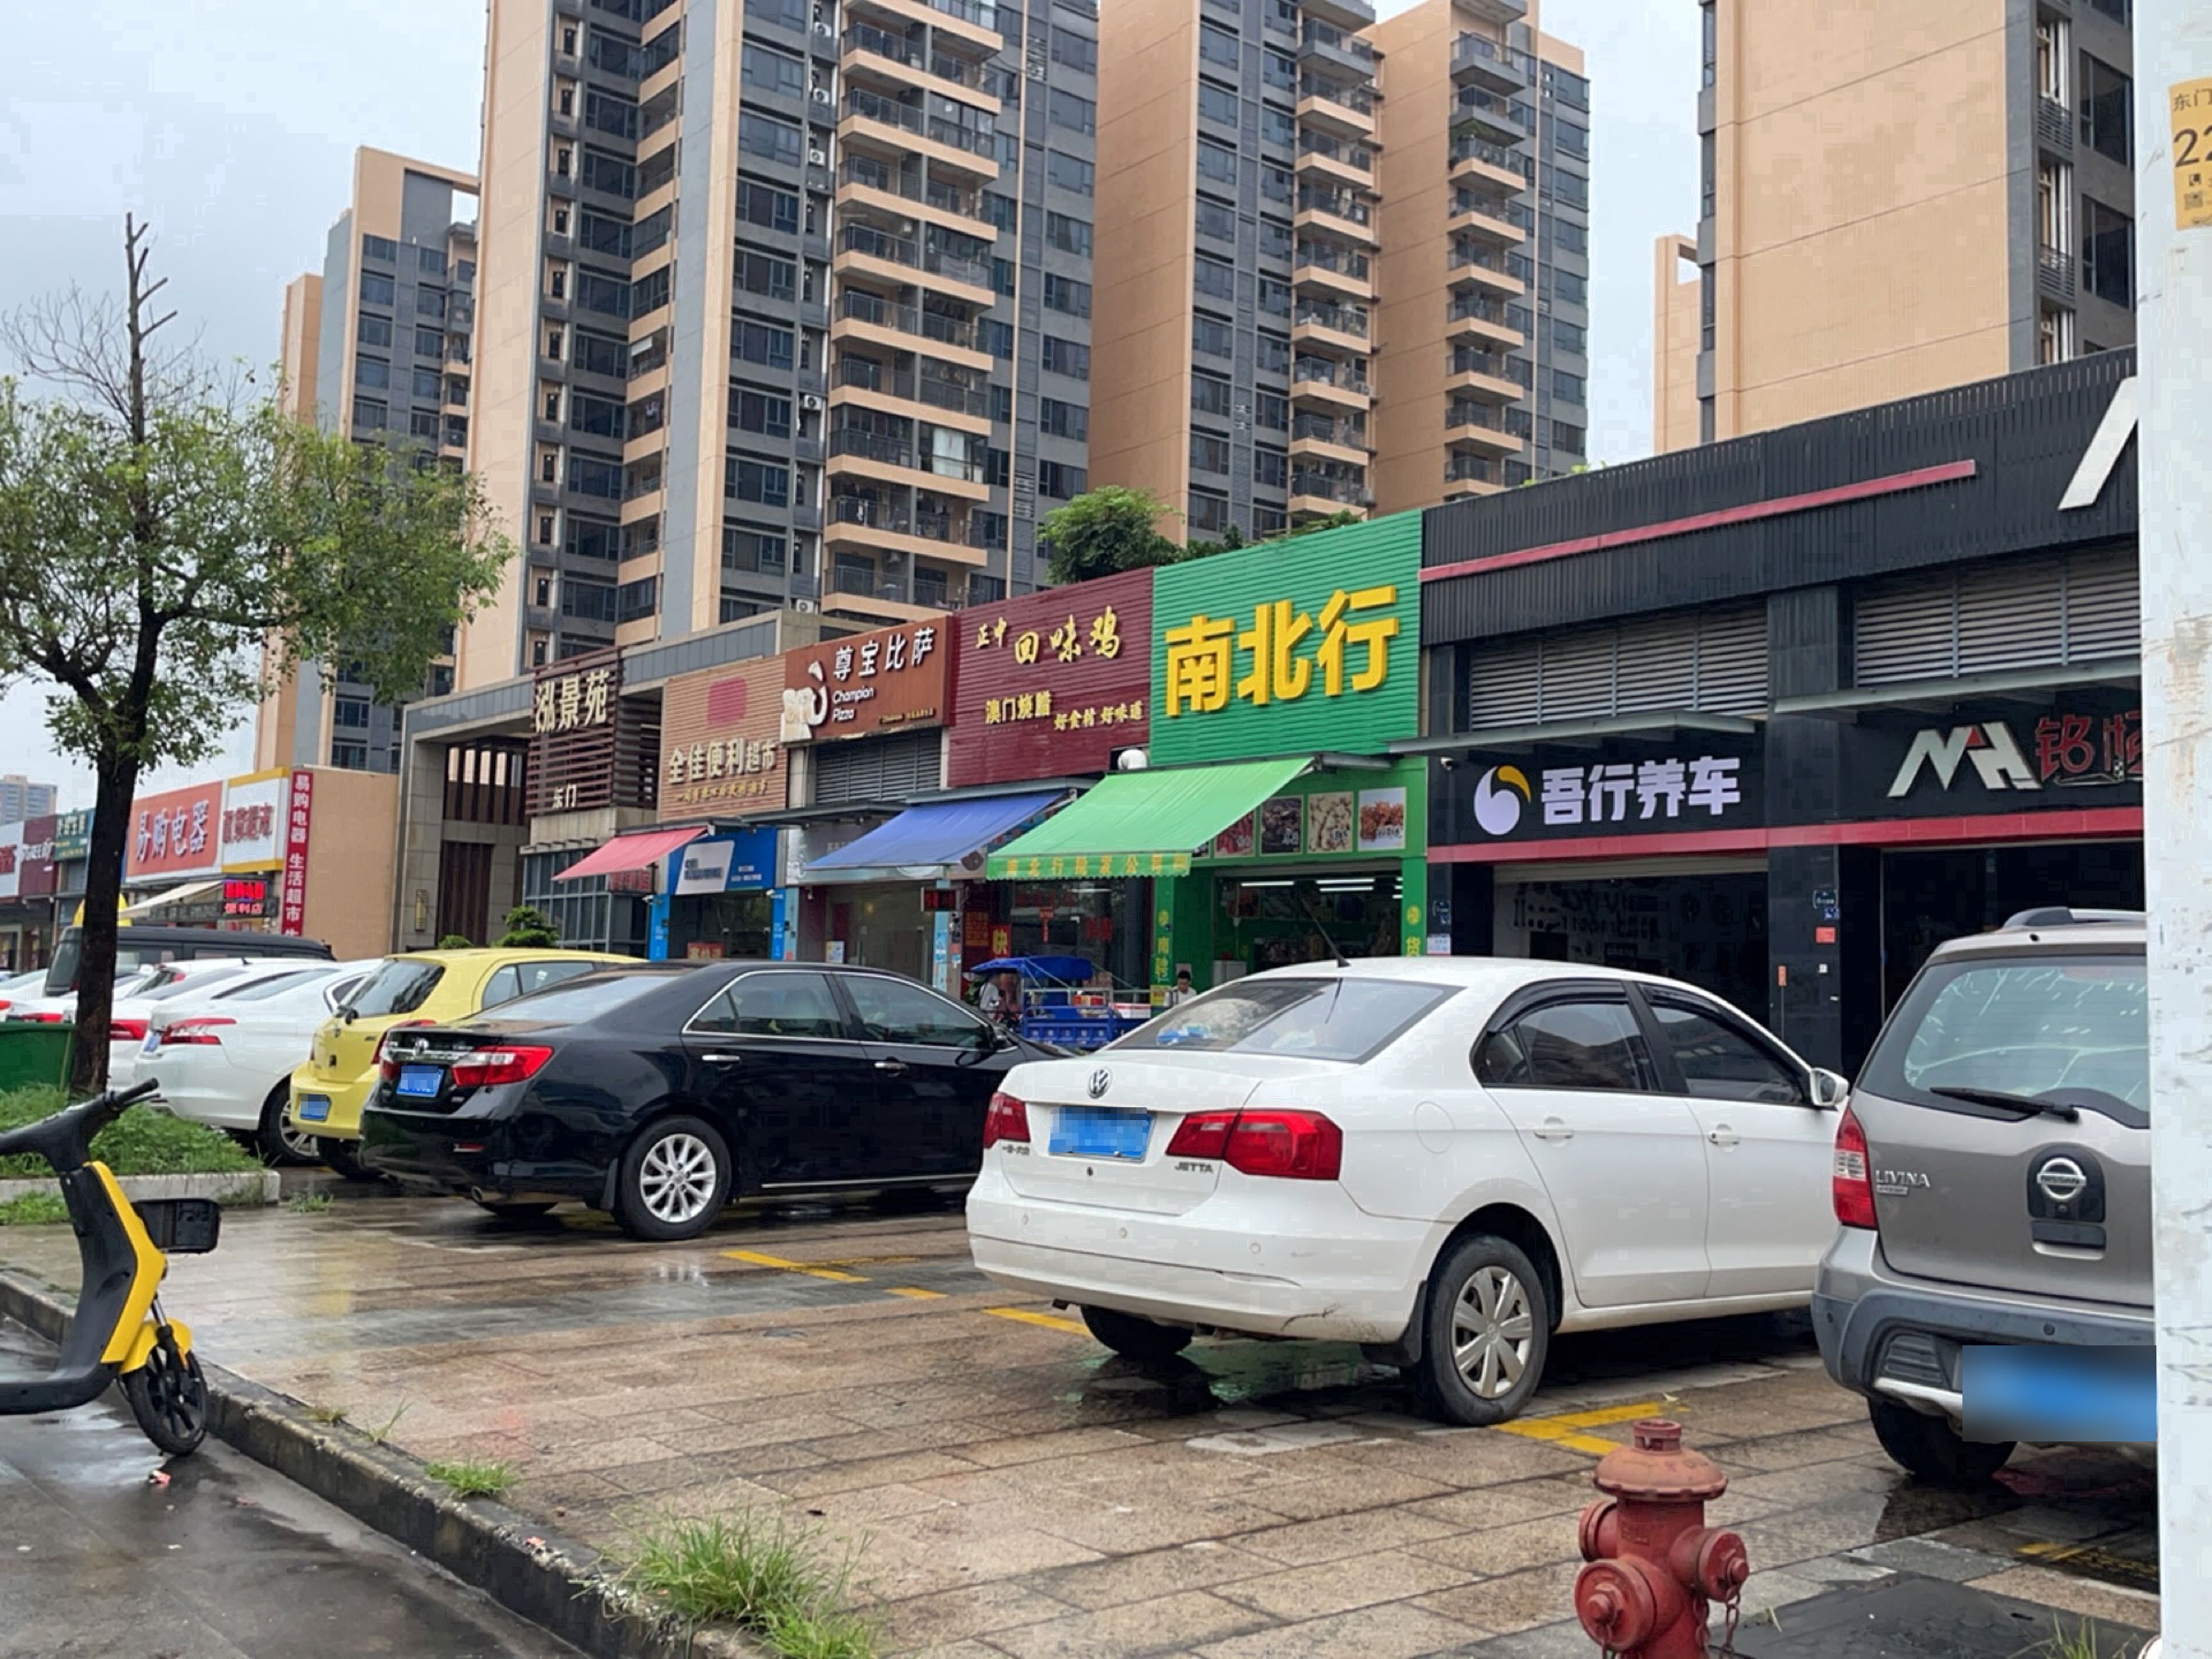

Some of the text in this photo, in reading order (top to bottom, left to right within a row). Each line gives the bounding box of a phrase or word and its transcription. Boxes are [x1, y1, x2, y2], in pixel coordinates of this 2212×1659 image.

[833, 627, 935, 681] 尊宝比萨
[1165, 585, 1399, 717] 南北行
[668, 737, 777, 785] 全佳便利超市
[1541, 756, 1740, 825] 吾行养车
[136, 800, 210, 863] 易购电器
[291, 774, 310, 844] 易购电器
[285, 853, 305, 922] 生活超市
[1174, 1161, 1214, 1173] JETTA
[1875, 1170, 1930, 1188] LIVINA
